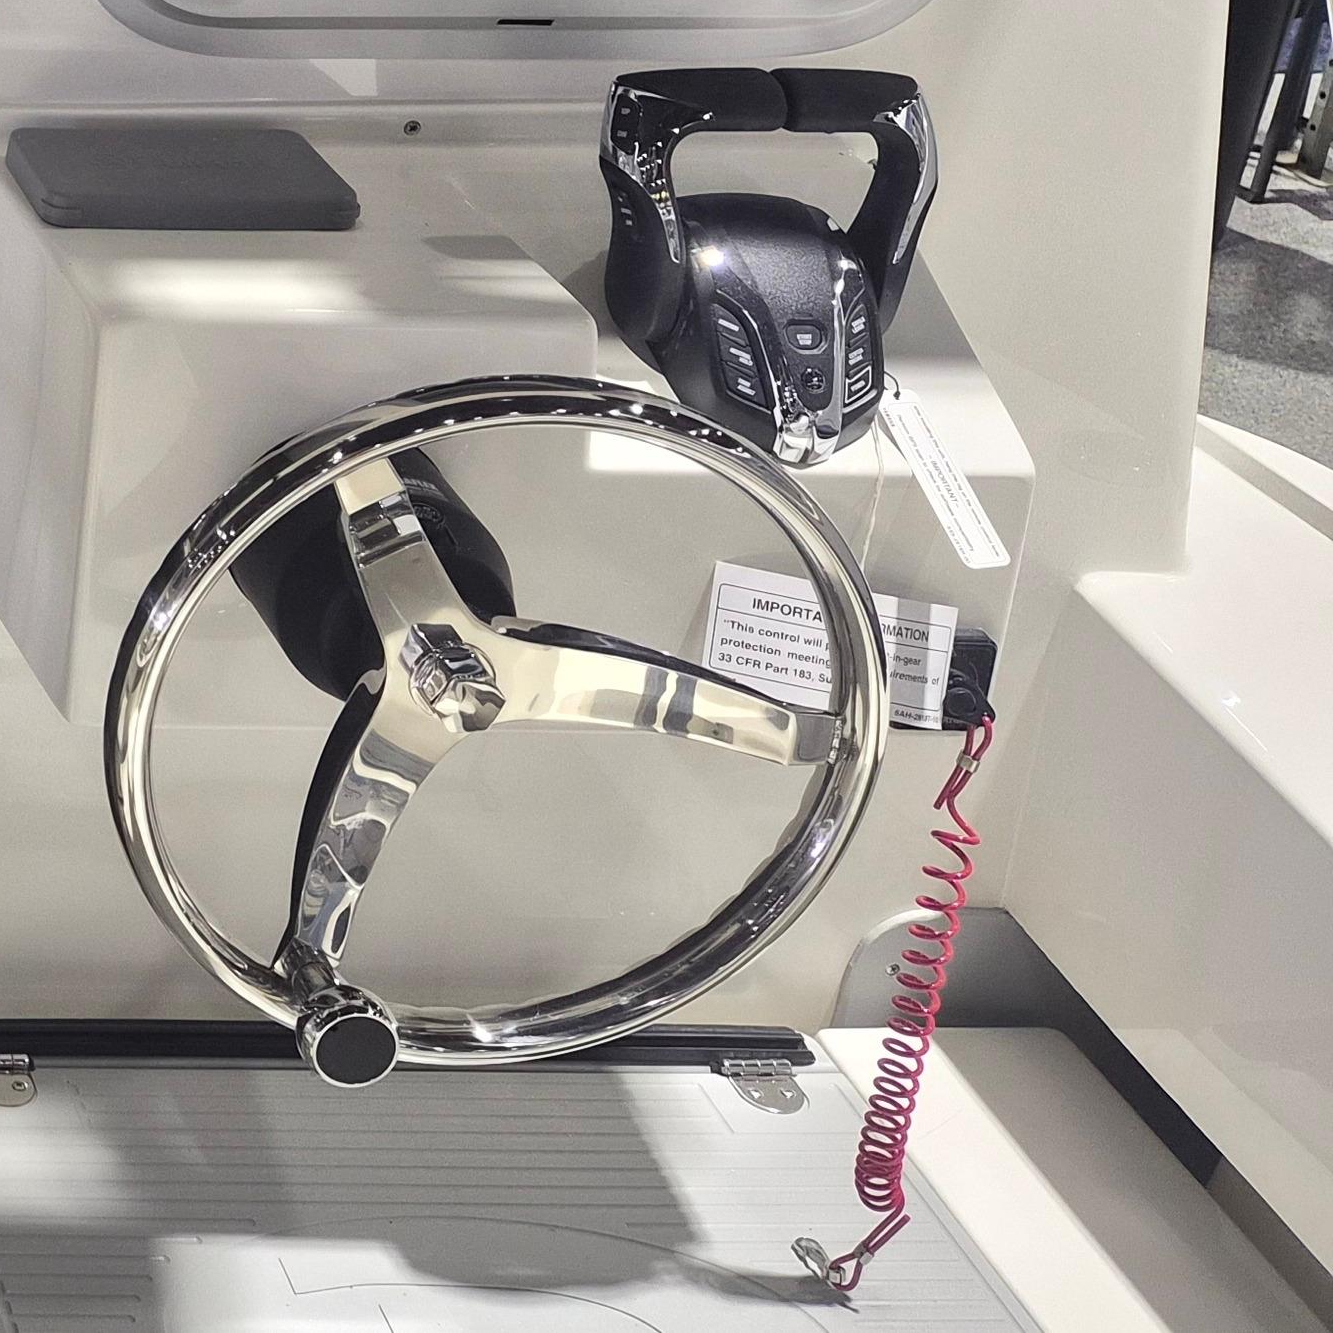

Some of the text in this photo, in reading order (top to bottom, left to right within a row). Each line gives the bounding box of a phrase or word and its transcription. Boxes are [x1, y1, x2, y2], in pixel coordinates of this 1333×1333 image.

[931, 459, 959, 503] IMPORTANT
[752, 597, 930, 643] IMPORTA RMATION
[758, 627, 800, 643] control
[803, 636, 822, 648] will
[718, 652, 732, 663] 33
[735, 656, 761, 669] CFR
[765, 662, 789, 675] Part
[720, 636, 781, 657] protection
[931, 677, 940, 686] of
